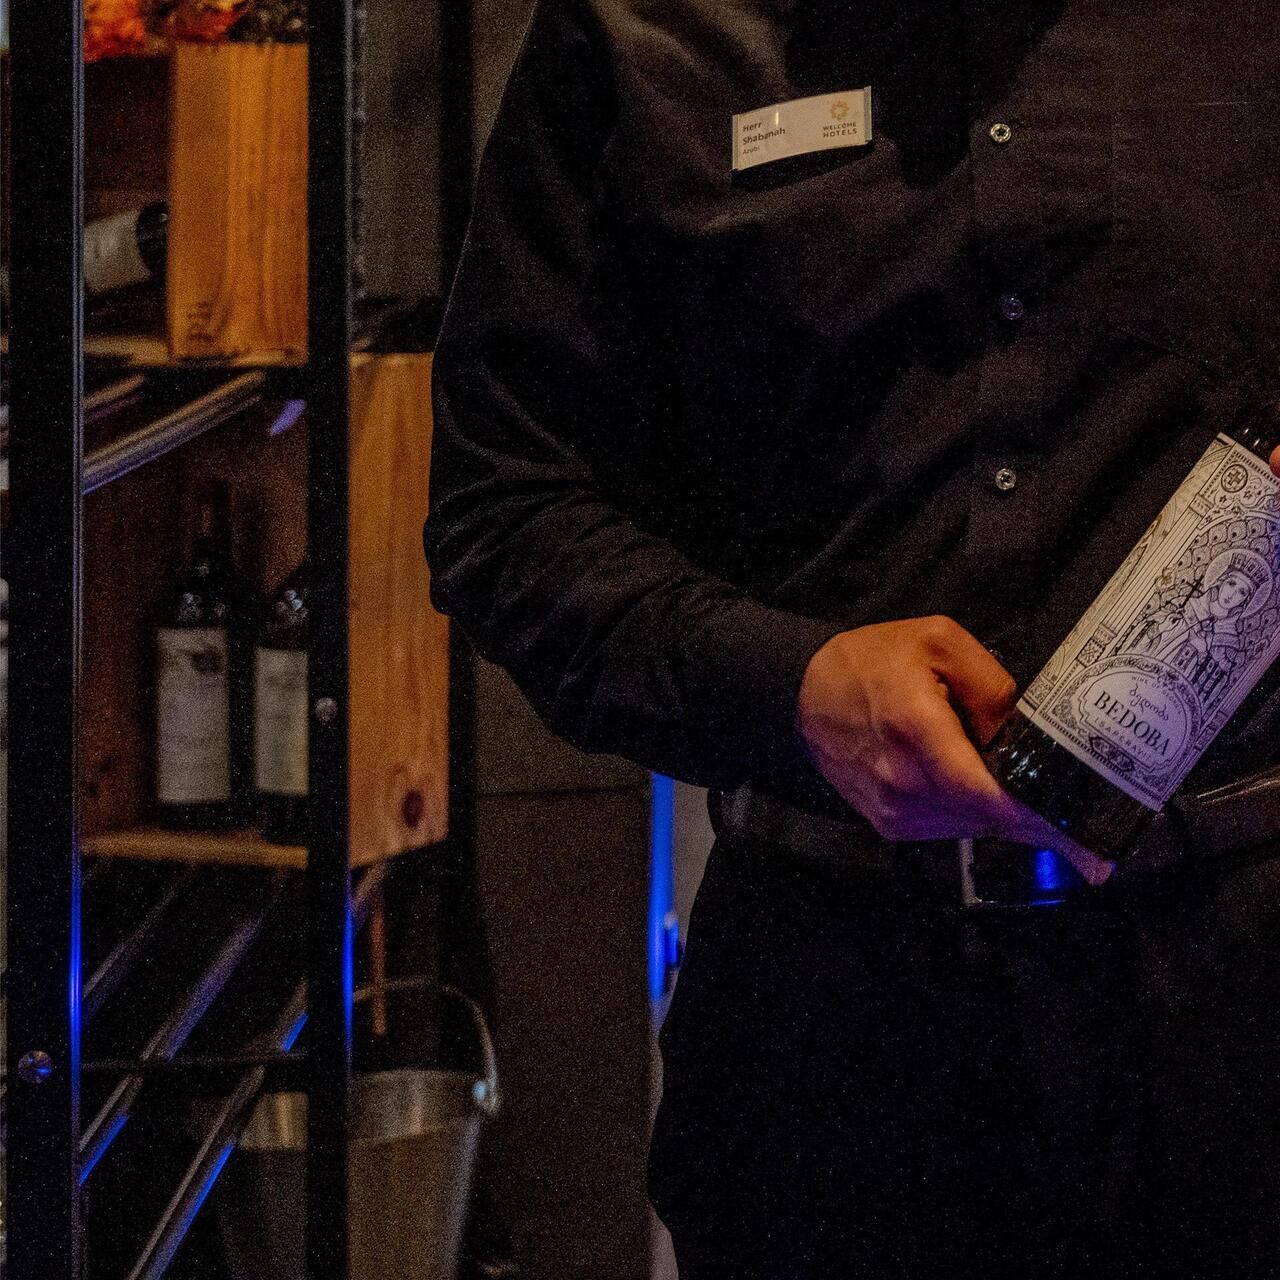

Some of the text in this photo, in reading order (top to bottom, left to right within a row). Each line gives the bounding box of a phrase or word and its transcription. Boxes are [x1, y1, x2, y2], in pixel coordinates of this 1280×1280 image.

[742, 122, 763, 133] Herr
[822, 121, 857, 131] WELCOME
[742, 127, 786, 146] Shabanah
[823, 128, 858, 139] HOTELS
[1094, 691, 1171, 756] BEDOBA
